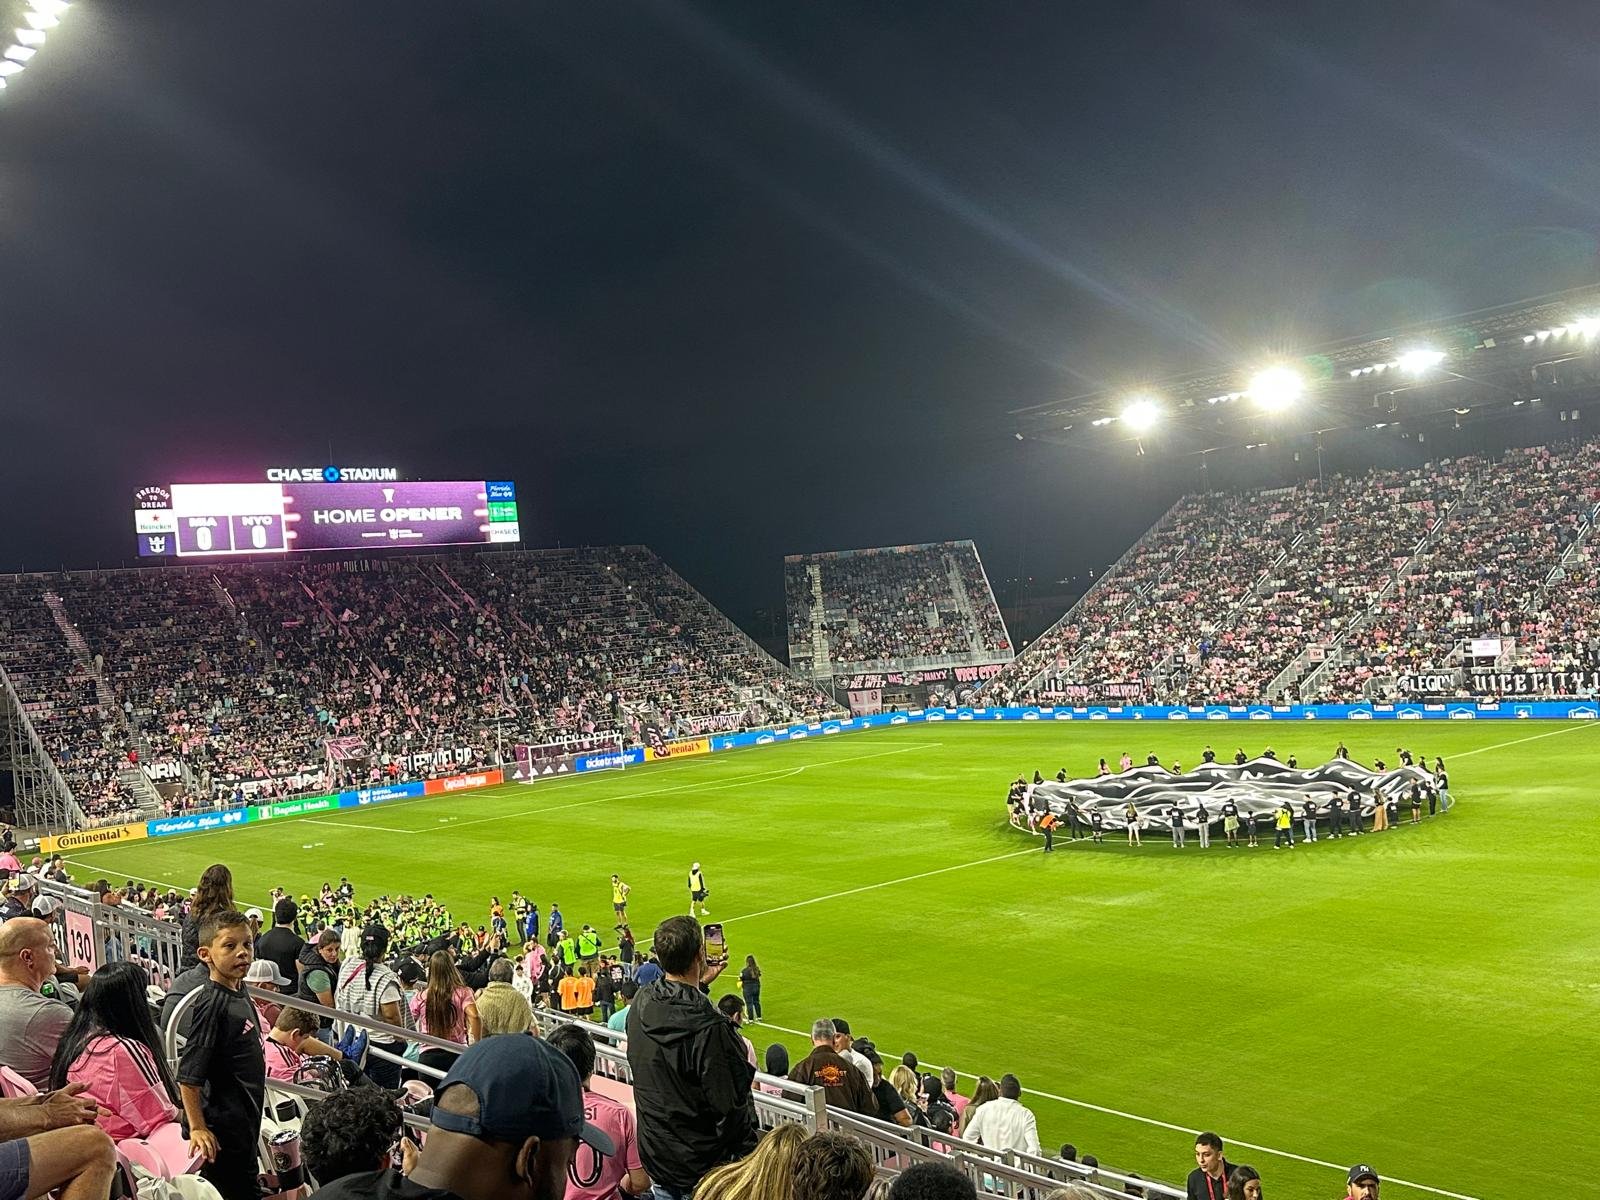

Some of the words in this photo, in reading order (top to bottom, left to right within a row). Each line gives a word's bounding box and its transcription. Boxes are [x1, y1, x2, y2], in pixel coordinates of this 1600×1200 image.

[267, 468, 324, 481] CHASE
[340, 468, 397, 481] STADIUM
[136, 487, 170, 500] FREEDOM
[141, 501, 167, 509] DREAM
[313, 509, 377, 524] HOME
[380, 507, 462, 522] OPENER
[197, 526, 213, 550] 0
[252, 525, 267, 548] 0
[671, 743, 695, 755] nental
[586, 754, 636, 768] ticketmaster
[303, 800, 330, 812] Health
[155, 818, 196, 833] Florida
[198, 816, 221, 828] Blue
[57, 828, 121, 849] Continental
[49, 922, 65, 954] 31
[71, 929, 91, 963] 130
